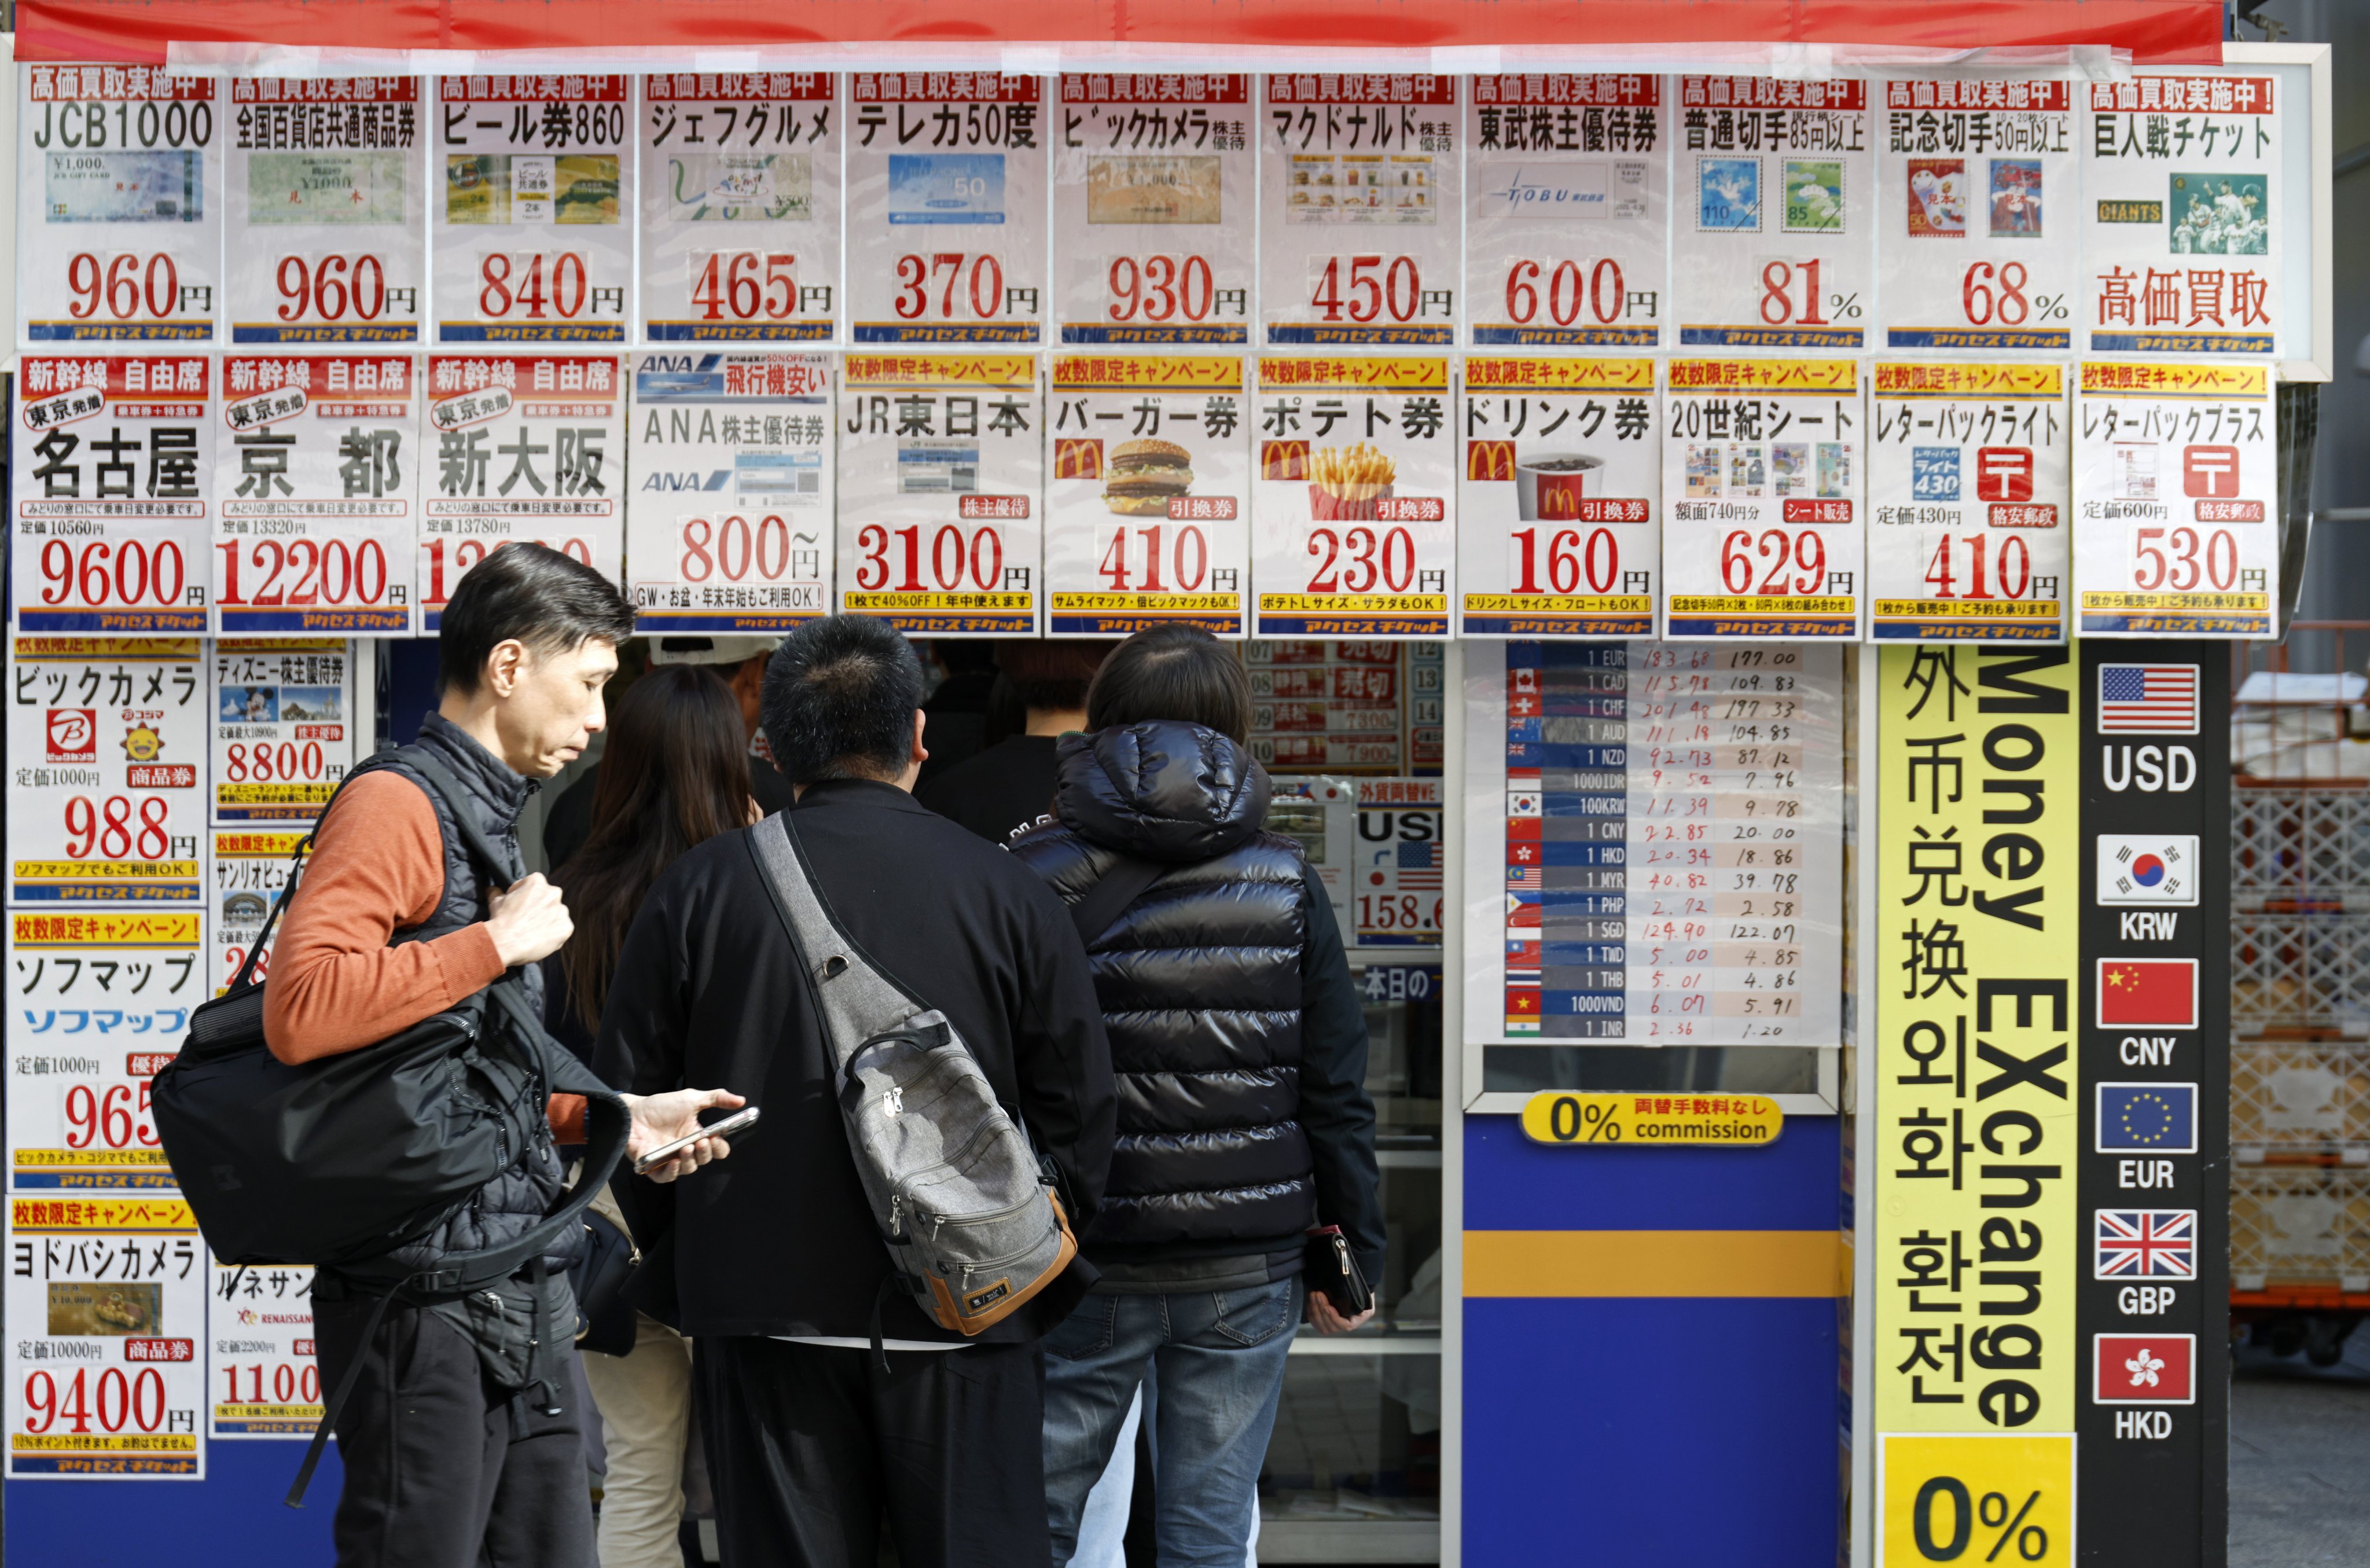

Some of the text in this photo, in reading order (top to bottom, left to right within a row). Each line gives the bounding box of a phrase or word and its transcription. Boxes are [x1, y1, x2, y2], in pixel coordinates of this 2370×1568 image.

[35, 101, 212, 148] JCB1000
[237, 104, 415, 149] 全国百貨店共通商品券
[444, 102, 623, 148] ビール券860
[652, 103, 829, 146] ジェフグルメ
[858, 104, 1037, 148] テレカ50度
[1065, 108, 1208, 149] ビックカメラ
[1273, 106, 1417, 150] マクドナルド
[1479, 107, 1656, 152] 東武株主優待券
[1685, 110, 1788, 152] 普通切手
[1891, 112, 1994, 153] 記念切手
[2095, 113, 2270, 159] 巨人戦チケット
[1703, 206, 1729, 219] 110
[1788, 207, 1807, 219] 85
[2100, 203, 2160, 221] GIANTS
[1761, 259, 1861, 324] 81%
[1963, 262, 2068, 325] 68%
[2097, 266, 2271, 327] 高価買取
[28, 360, 203, 391] 新幹線 自由席
[639, 357, 696, 372] ANA
[847, 358, 1033, 381] 枚数限定キャンペーン！
[1670, 362, 1855, 385] 枚数限定キャンペーン！
[2084, 365, 2266, 391] 枚数限定キャンペーン！
[726, 366, 825, 395] 飛行機安い
[847, 395, 1030, 436] JR東日本
[1056, 397, 1237, 438] バーガー券
[1262, 397, 1443, 438] ポテト券
[1469, 398, 1649, 440] ドリンク券
[1672, 400, 1852, 441] 20世紀シート
[1877, 403, 2059, 446] レターパックライト
[2084, 403, 2264, 443] レターパックプラス
[32, 428, 199, 498] 名古屋
[439, 426, 607, 497] 新大阪
[1914, 475, 1959, 494] 430
[964, 498, 1026, 516] 株主優待
[1171, 500, 1232, 516] 引換券
[1675, 503, 1759, 520] 額面740円分
[1787, 503, 1848, 520] シート販売
[1876, 506, 1961, 525] 定価430円
[1993, 507, 2054, 525] 格安郵政
[2084, 502, 2167, 519] 定価600円
[217, 656, 343, 685] ディズニー株主優待券
[1603, 651, 1625, 666] EUR
[16, 665, 196, 706] ビックカメラ
[1603, 675, 1625, 691] CAD
[1603, 700, 1625, 715] CHF
[1603, 726, 1625, 740] AUD
[1602, 750, 1625, 765] NZD
[2103, 745, 2196, 792] USD
[16, 768, 99, 787] 定価1000円
[131, 768, 192, 785] 商品券
[1574, 773, 1625, 789] 1000IDR
[1974, 645, 2070, 932] Money
[1580, 798, 1626, 813] 100KRW
[1601, 823, 1625, 839] CNY
[1601, 847, 1625, 864] HKD
[1601, 872, 1625, 888] MYR
[1601, 897, 1625, 912] PHP
[16, 916, 198, 941] 枚数限定キャンペーン！
[1601, 921, 1625, 938] SGD
[2121, 912, 2178, 940] KRW
[17, 953, 195, 994] ソフマップ
[1571, 996, 1625, 1012] 1000VND
[24, 1007, 188, 1033] ソフマップ
[2120, 1037, 2176, 1066] CNY
[1550, 1096, 1621, 1142] 0%
[1635, 1098, 1768, 1115] 両替手数料なし
[1636, 1119, 1768, 1139] commission
[2118, 1160, 2175, 1188] EUR
[14, 1238, 194, 1280] ヨドバシカメラ
[2118, 1287, 2176, 1314] GBP
[17, 1340, 102, 1360] 定価10000円
[2115, 1411, 2173, 1439] HKD
[1913, 1475, 2048, 1562] 0%
